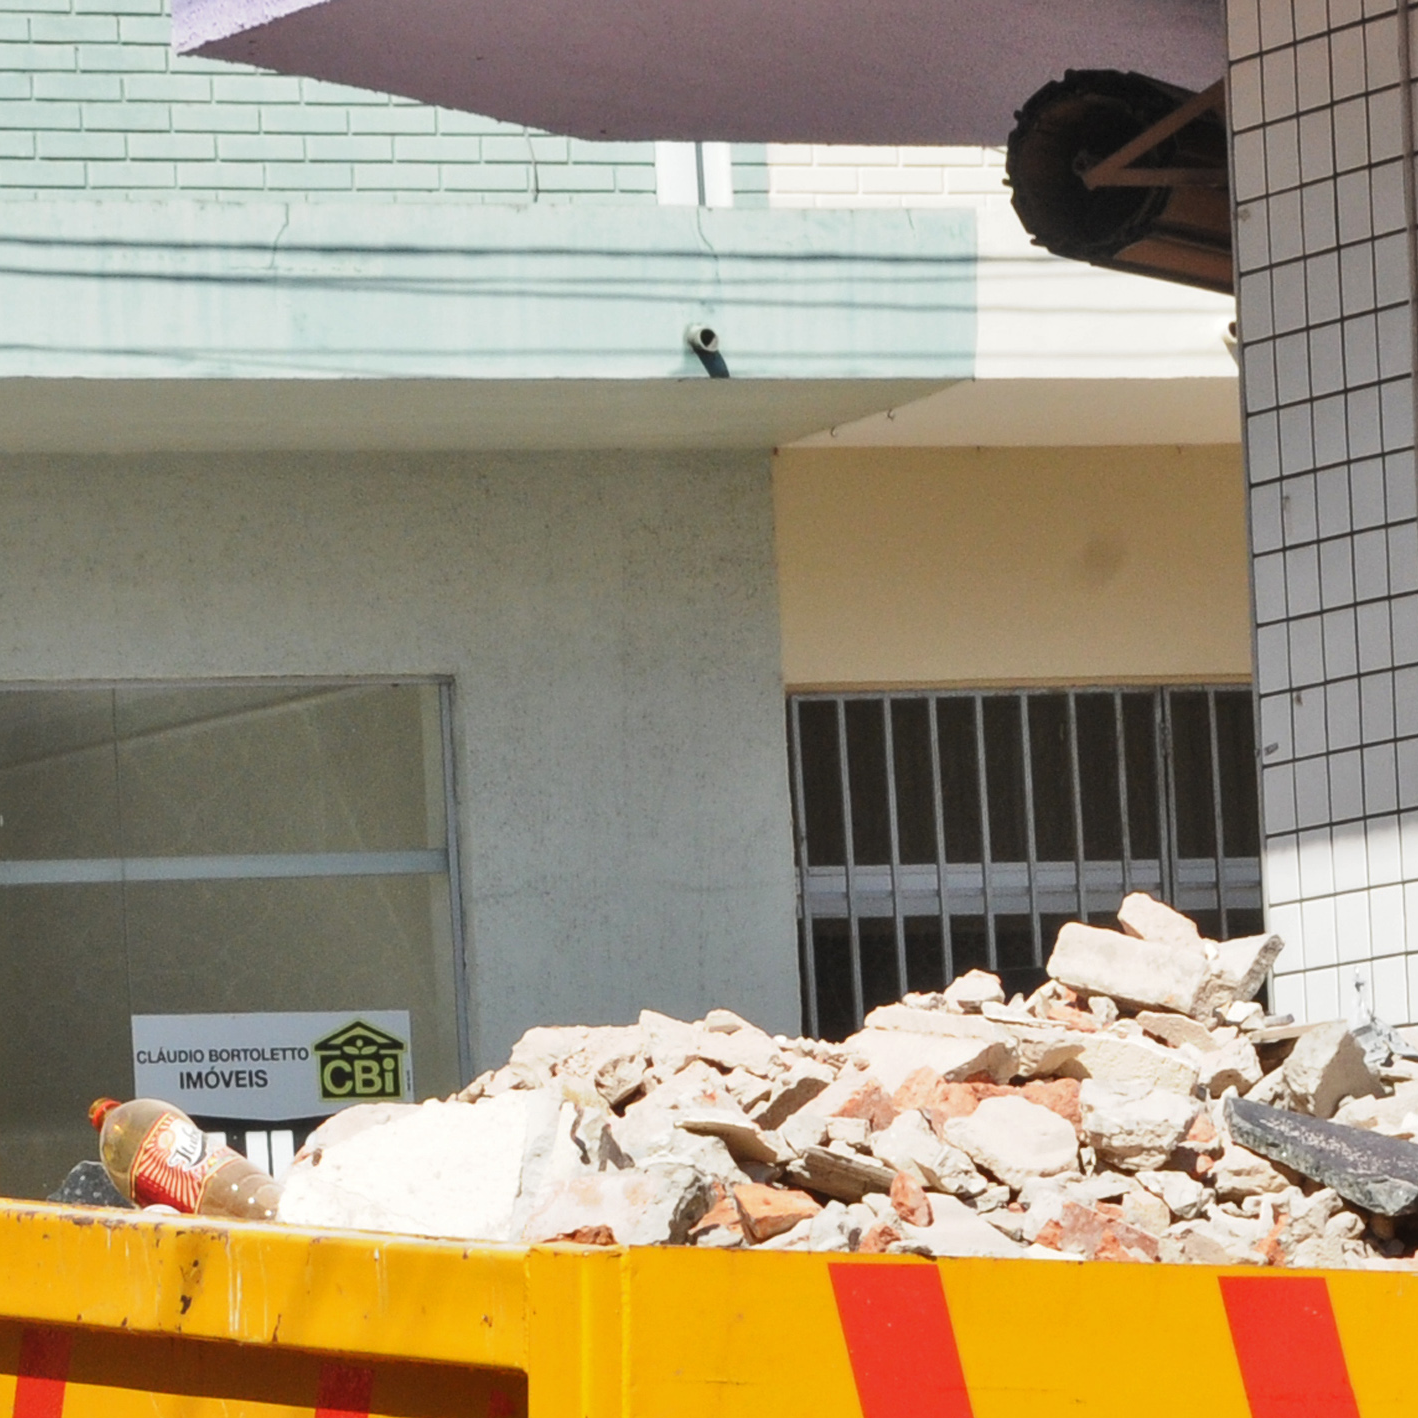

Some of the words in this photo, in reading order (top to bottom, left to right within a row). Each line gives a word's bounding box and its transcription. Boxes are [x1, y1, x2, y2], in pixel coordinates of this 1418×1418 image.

[136, 1046, 205, 1065] CLÁUDIO
[208, 1047, 310, 1064] BORTOLETTO
[179, 1066, 269, 1090] IMÓVEIS
